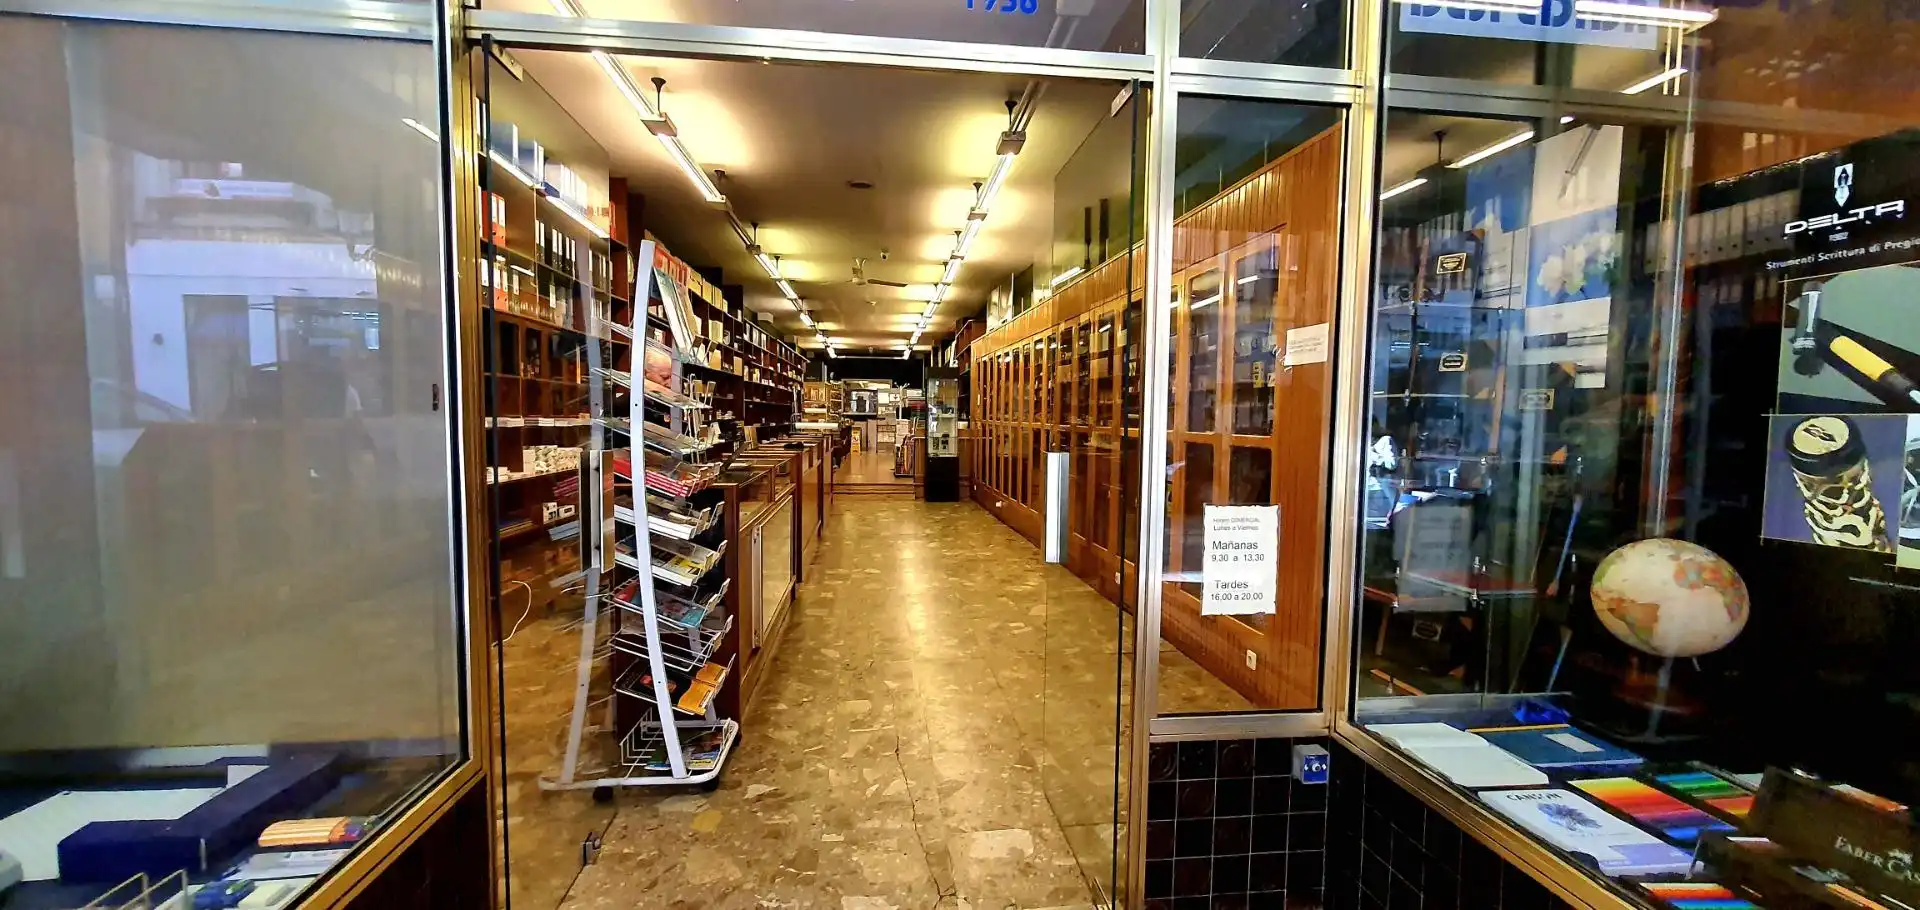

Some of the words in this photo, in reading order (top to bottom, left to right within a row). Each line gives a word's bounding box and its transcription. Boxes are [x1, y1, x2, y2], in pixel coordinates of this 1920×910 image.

[1784, 200, 1905, 234] DELTA
[1766, 253, 1815, 270] Strumenti
[1817, 247, 1866, 262] Scrittura
[1868, 243, 1881, 253] di
[1212, 540, 1259, 550] Mañanas
[1214, 580, 1249, 589] Tardes
[1834, 836, 1884, 868] FABER
